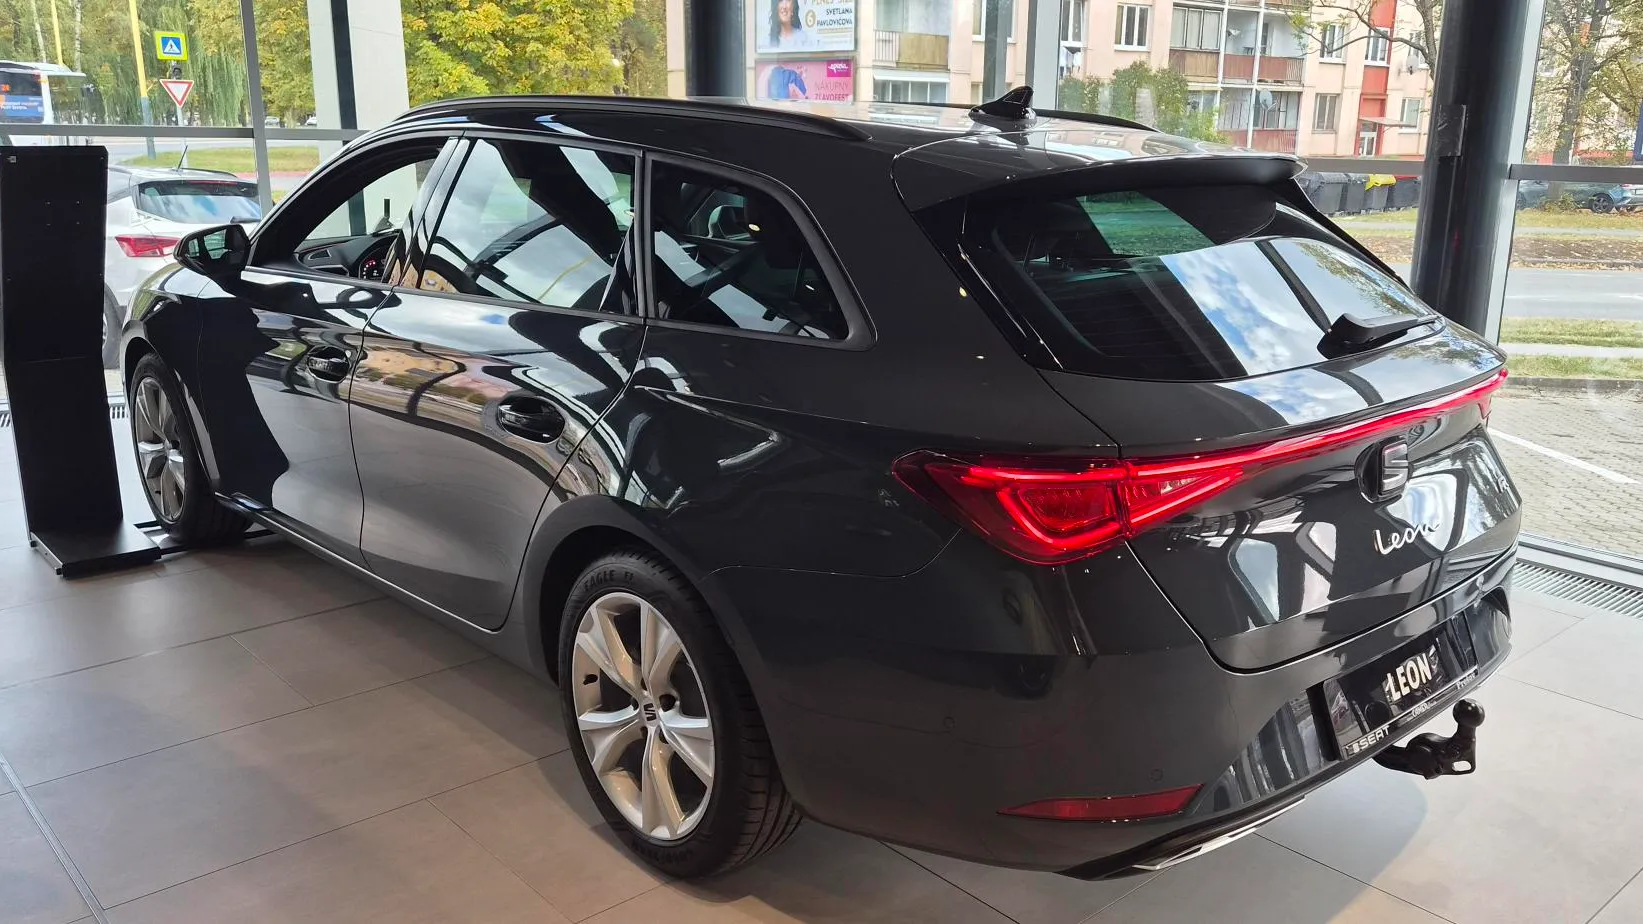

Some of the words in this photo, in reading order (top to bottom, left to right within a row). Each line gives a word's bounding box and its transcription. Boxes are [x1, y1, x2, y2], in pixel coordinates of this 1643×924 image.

[1374, 523, 1440, 555] Leon
[584, 569, 616, 591] EAGLE
[1386, 652, 1432, 701] LEON
[1360, 724, 1390, 750] SEAT
